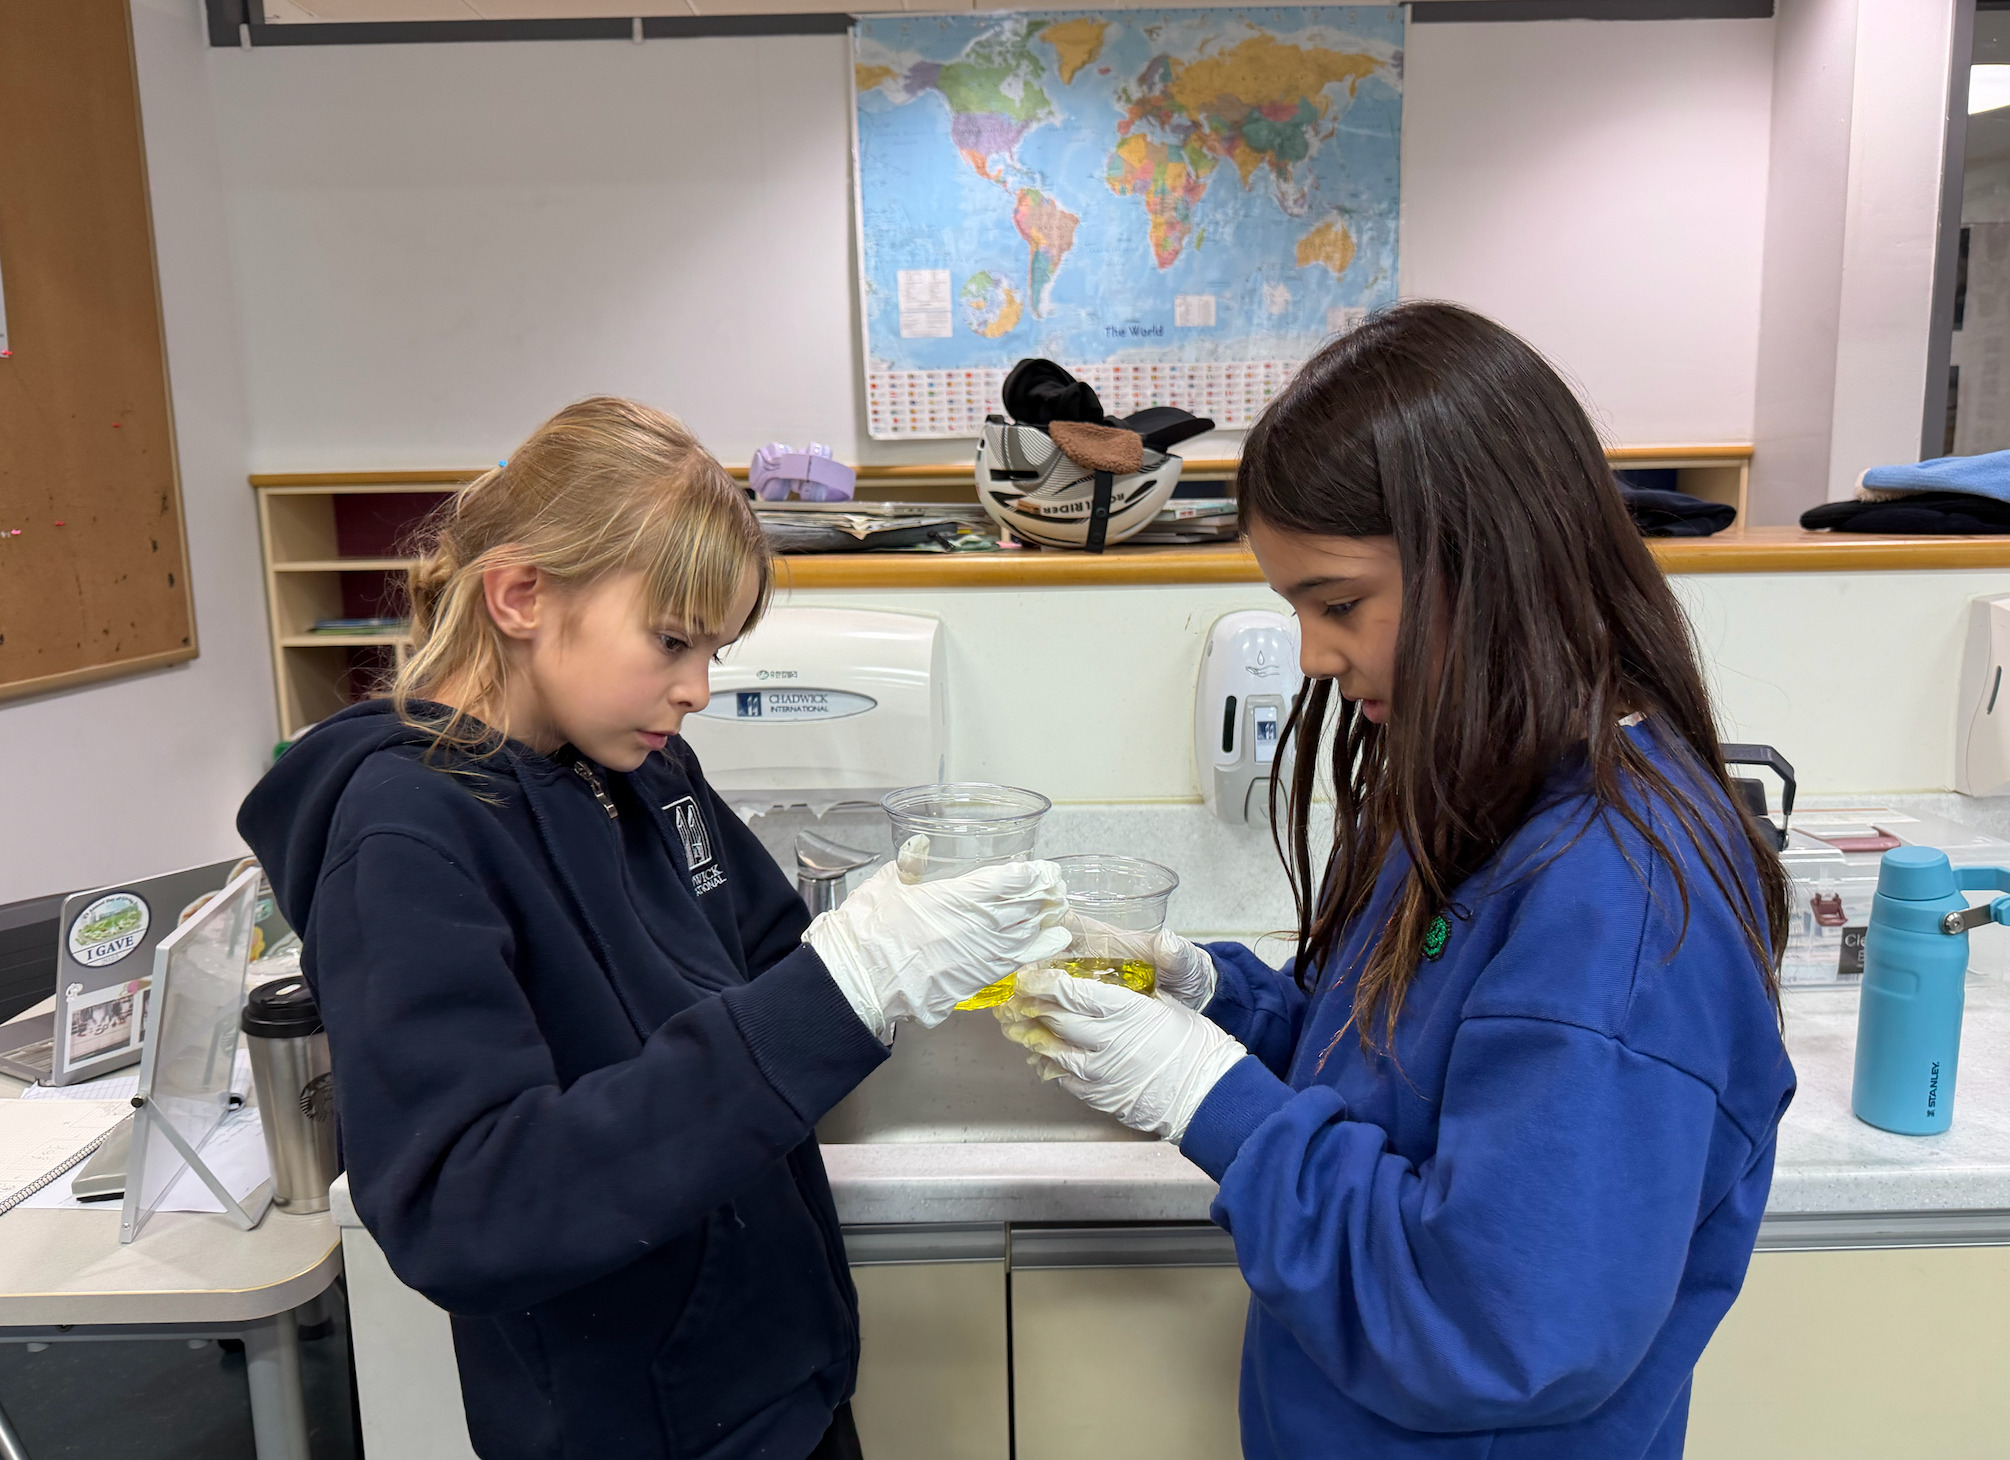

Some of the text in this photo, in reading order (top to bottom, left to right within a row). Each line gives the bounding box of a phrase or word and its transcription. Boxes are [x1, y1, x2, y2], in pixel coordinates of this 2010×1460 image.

[1104, 325, 1164, 337] The World
[769, 694, 828, 704] CHADWICK
[87, 949, 93, 961] I
[96, 935, 134, 957] GAVE
